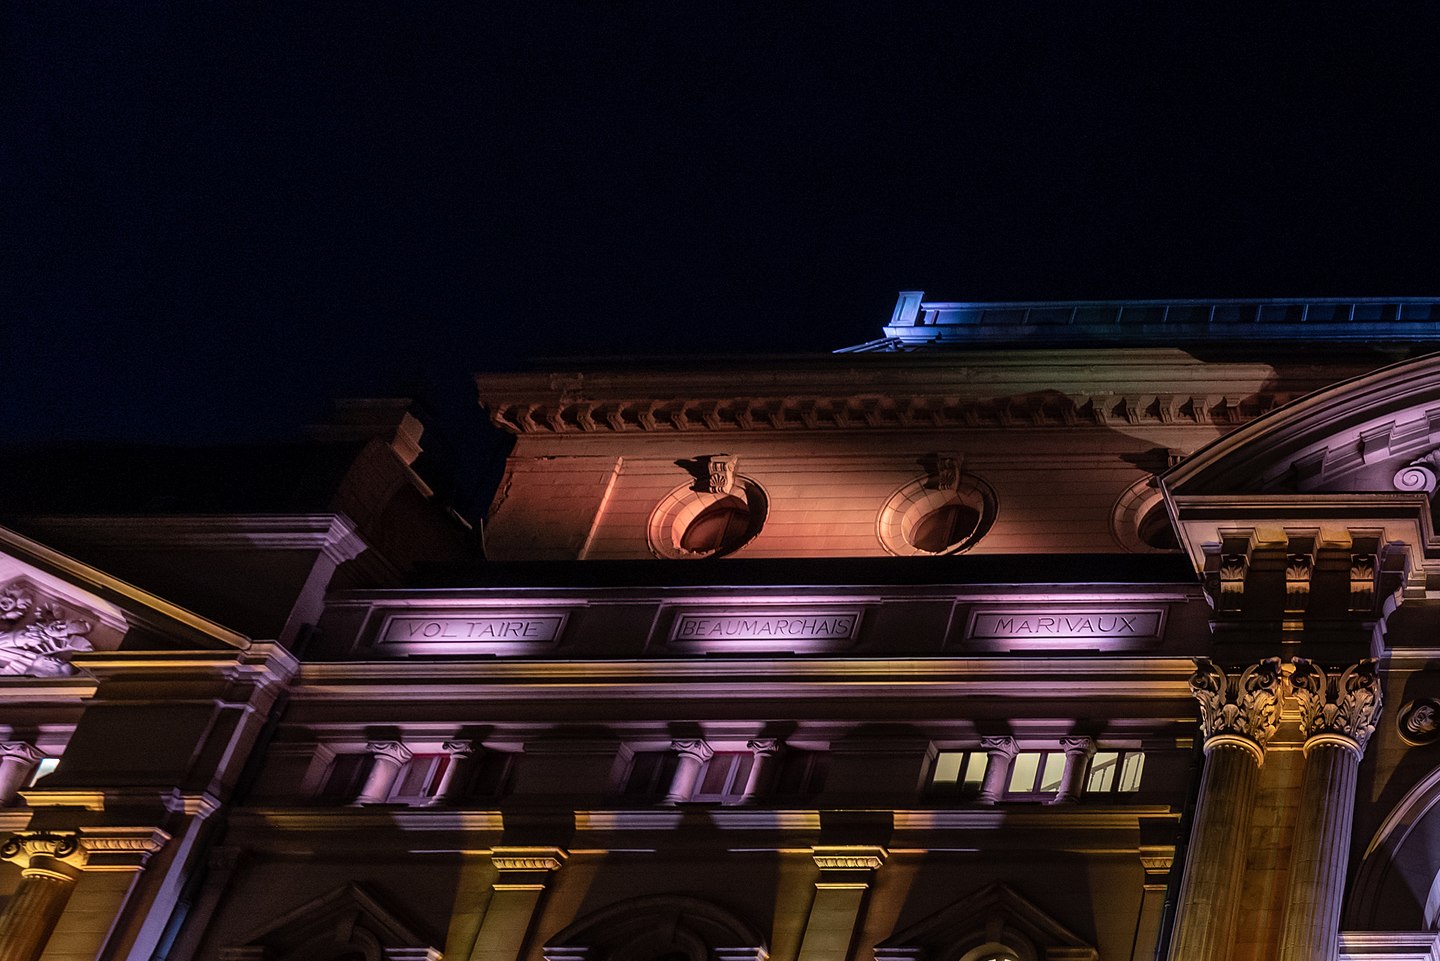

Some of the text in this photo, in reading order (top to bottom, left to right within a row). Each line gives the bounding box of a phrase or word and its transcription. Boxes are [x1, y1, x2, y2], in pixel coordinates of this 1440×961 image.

[407, 620, 545, 638] VOLTAIRE
[681, 617, 852, 637] BEAUMARCHAIS
[992, 616, 1137, 634] MARIVAUX
